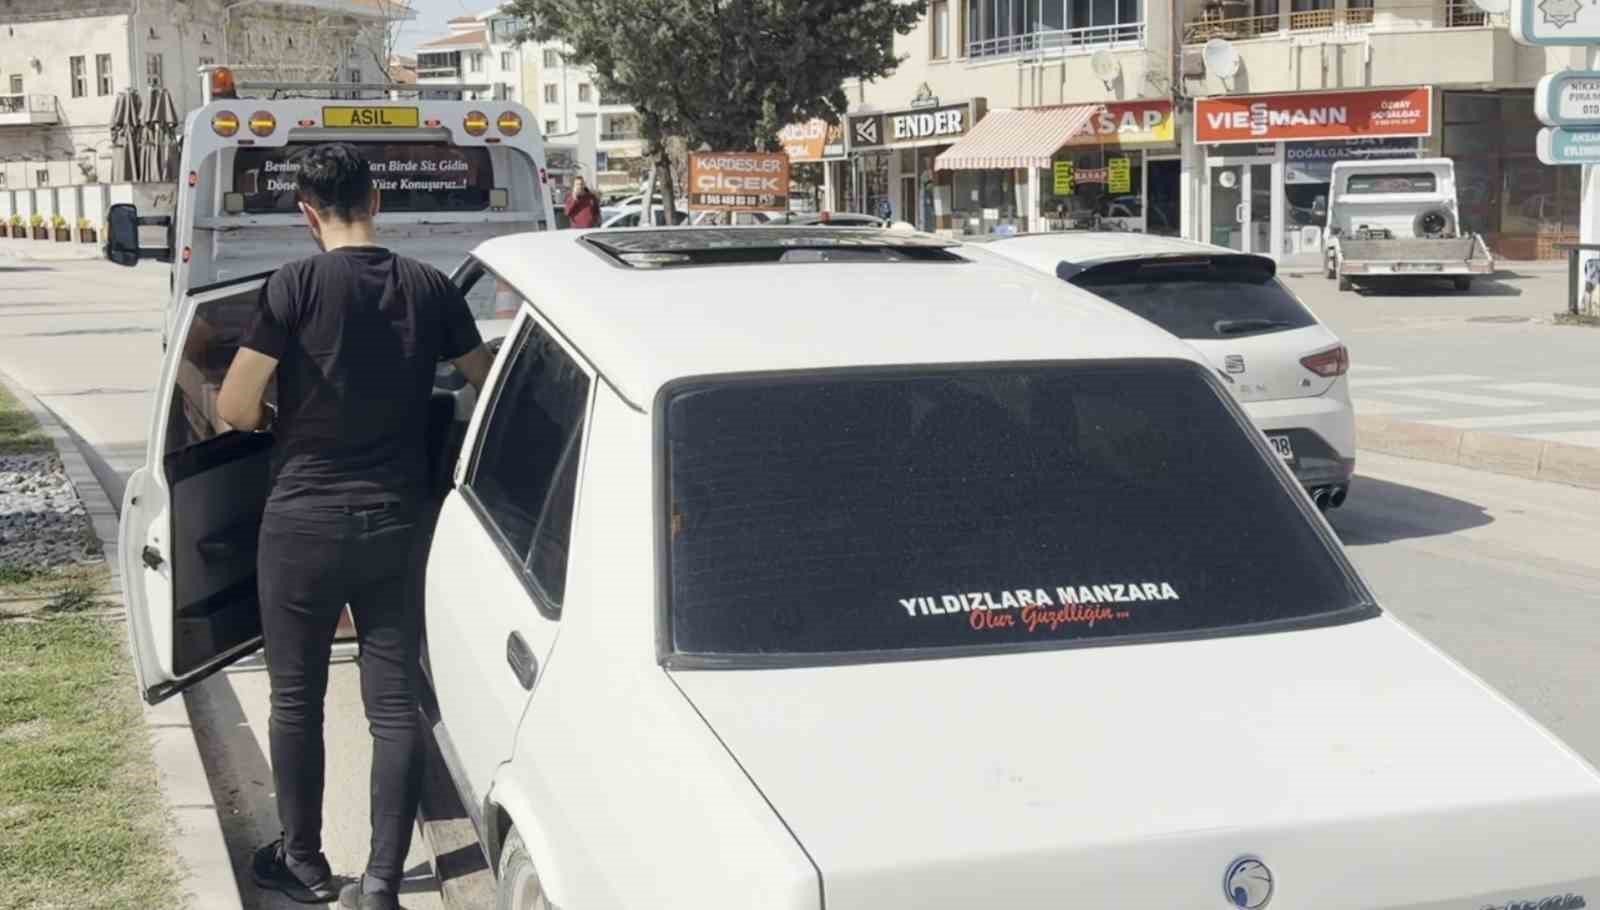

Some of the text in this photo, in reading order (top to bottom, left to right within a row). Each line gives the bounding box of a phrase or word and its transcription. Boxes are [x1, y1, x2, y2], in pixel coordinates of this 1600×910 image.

[351, 109, 392, 125] ASIL
[893, 109, 964, 139] ENDER
[388, 160, 418, 171] Birde
[439, 159, 469, 171] Gidin
[899, 581, 1180, 617] YILDIZLARA MANZARA
[969, 609, 1015, 631] Olur
